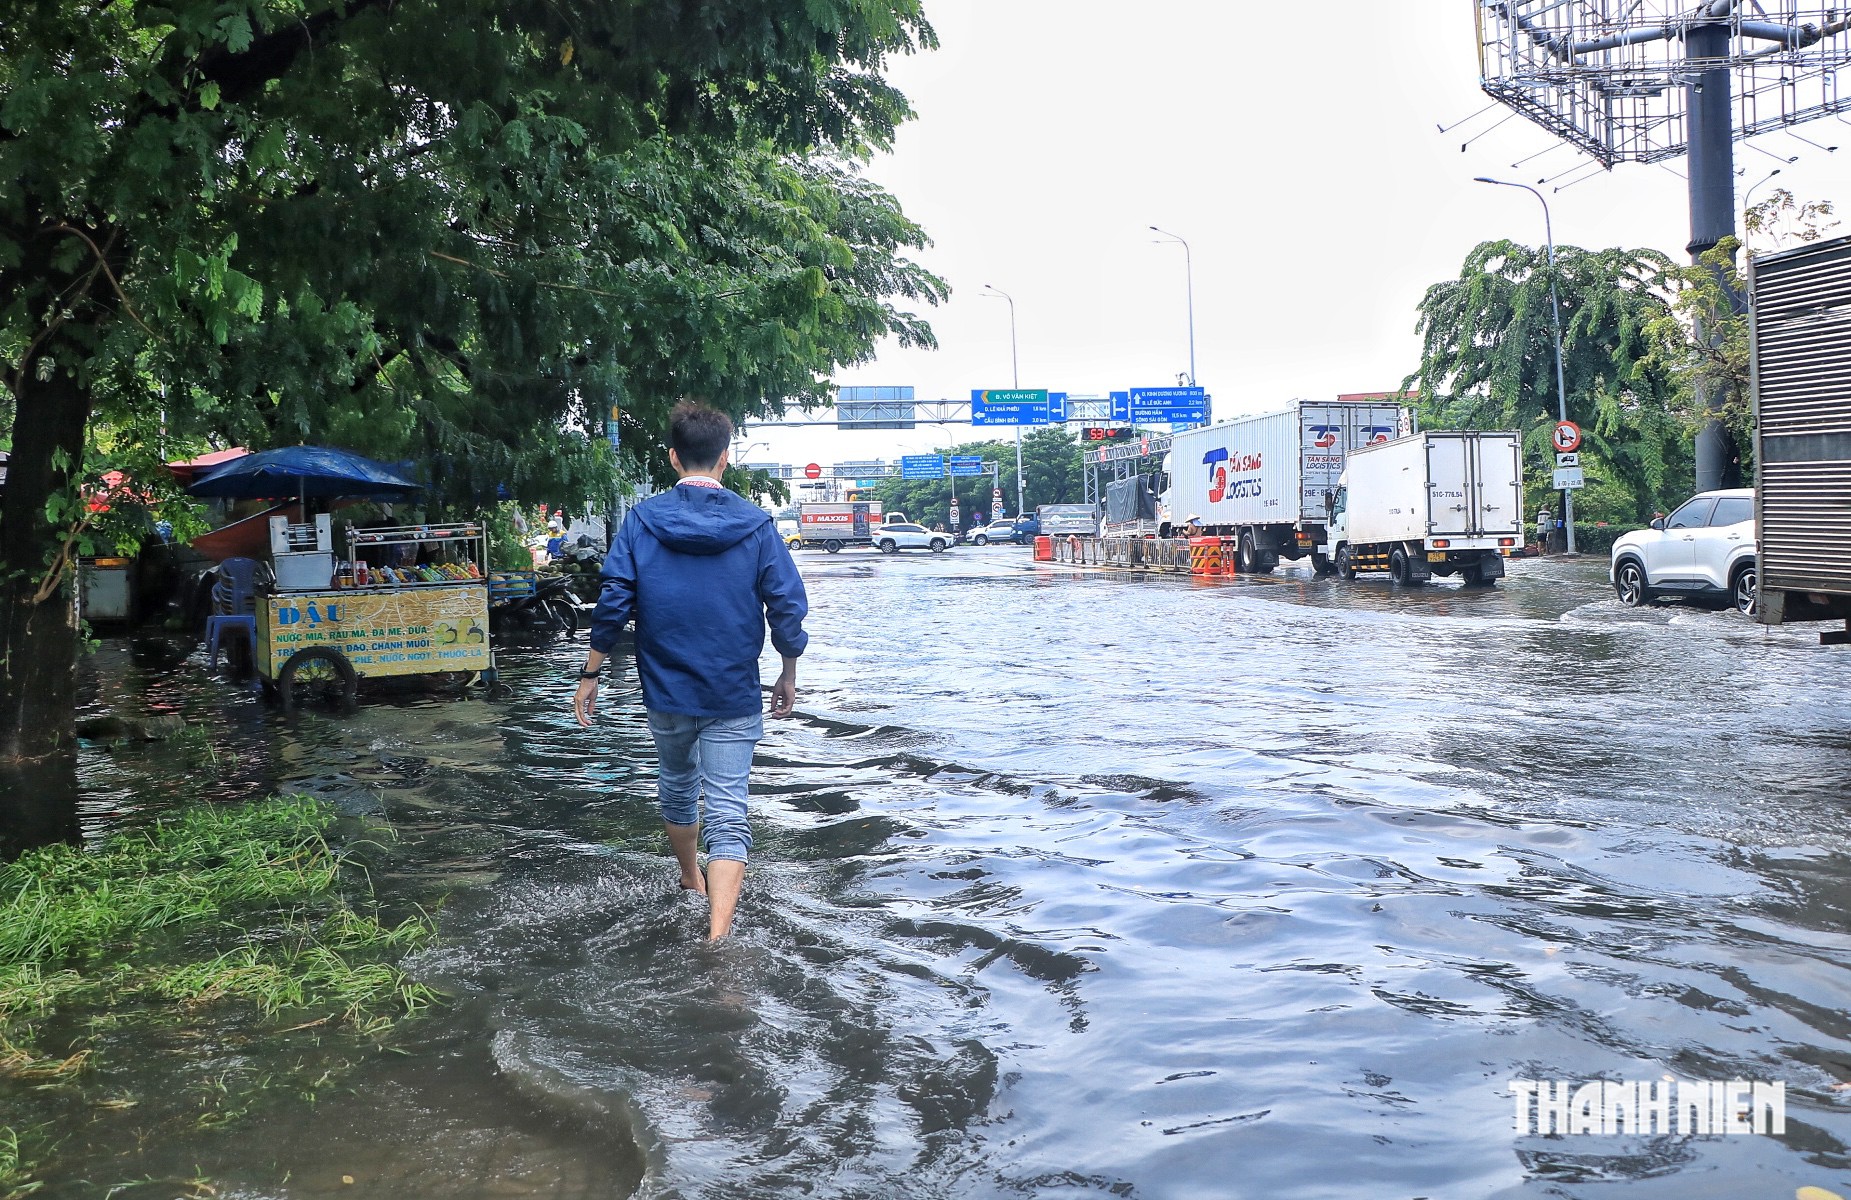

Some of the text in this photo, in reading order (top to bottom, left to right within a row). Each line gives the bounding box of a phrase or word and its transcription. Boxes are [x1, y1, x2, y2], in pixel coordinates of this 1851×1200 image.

[1090, 428, 1104, 440] 53
[1306, 462, 1342, 470] LOGISTICS
[1226, 477, 1262, 500] LOGISTICS
[1484, 569, 1502, 577] ISUZU
[329, 630, 348, 640] RAU
[371, 641, 403, 651] CHANH
